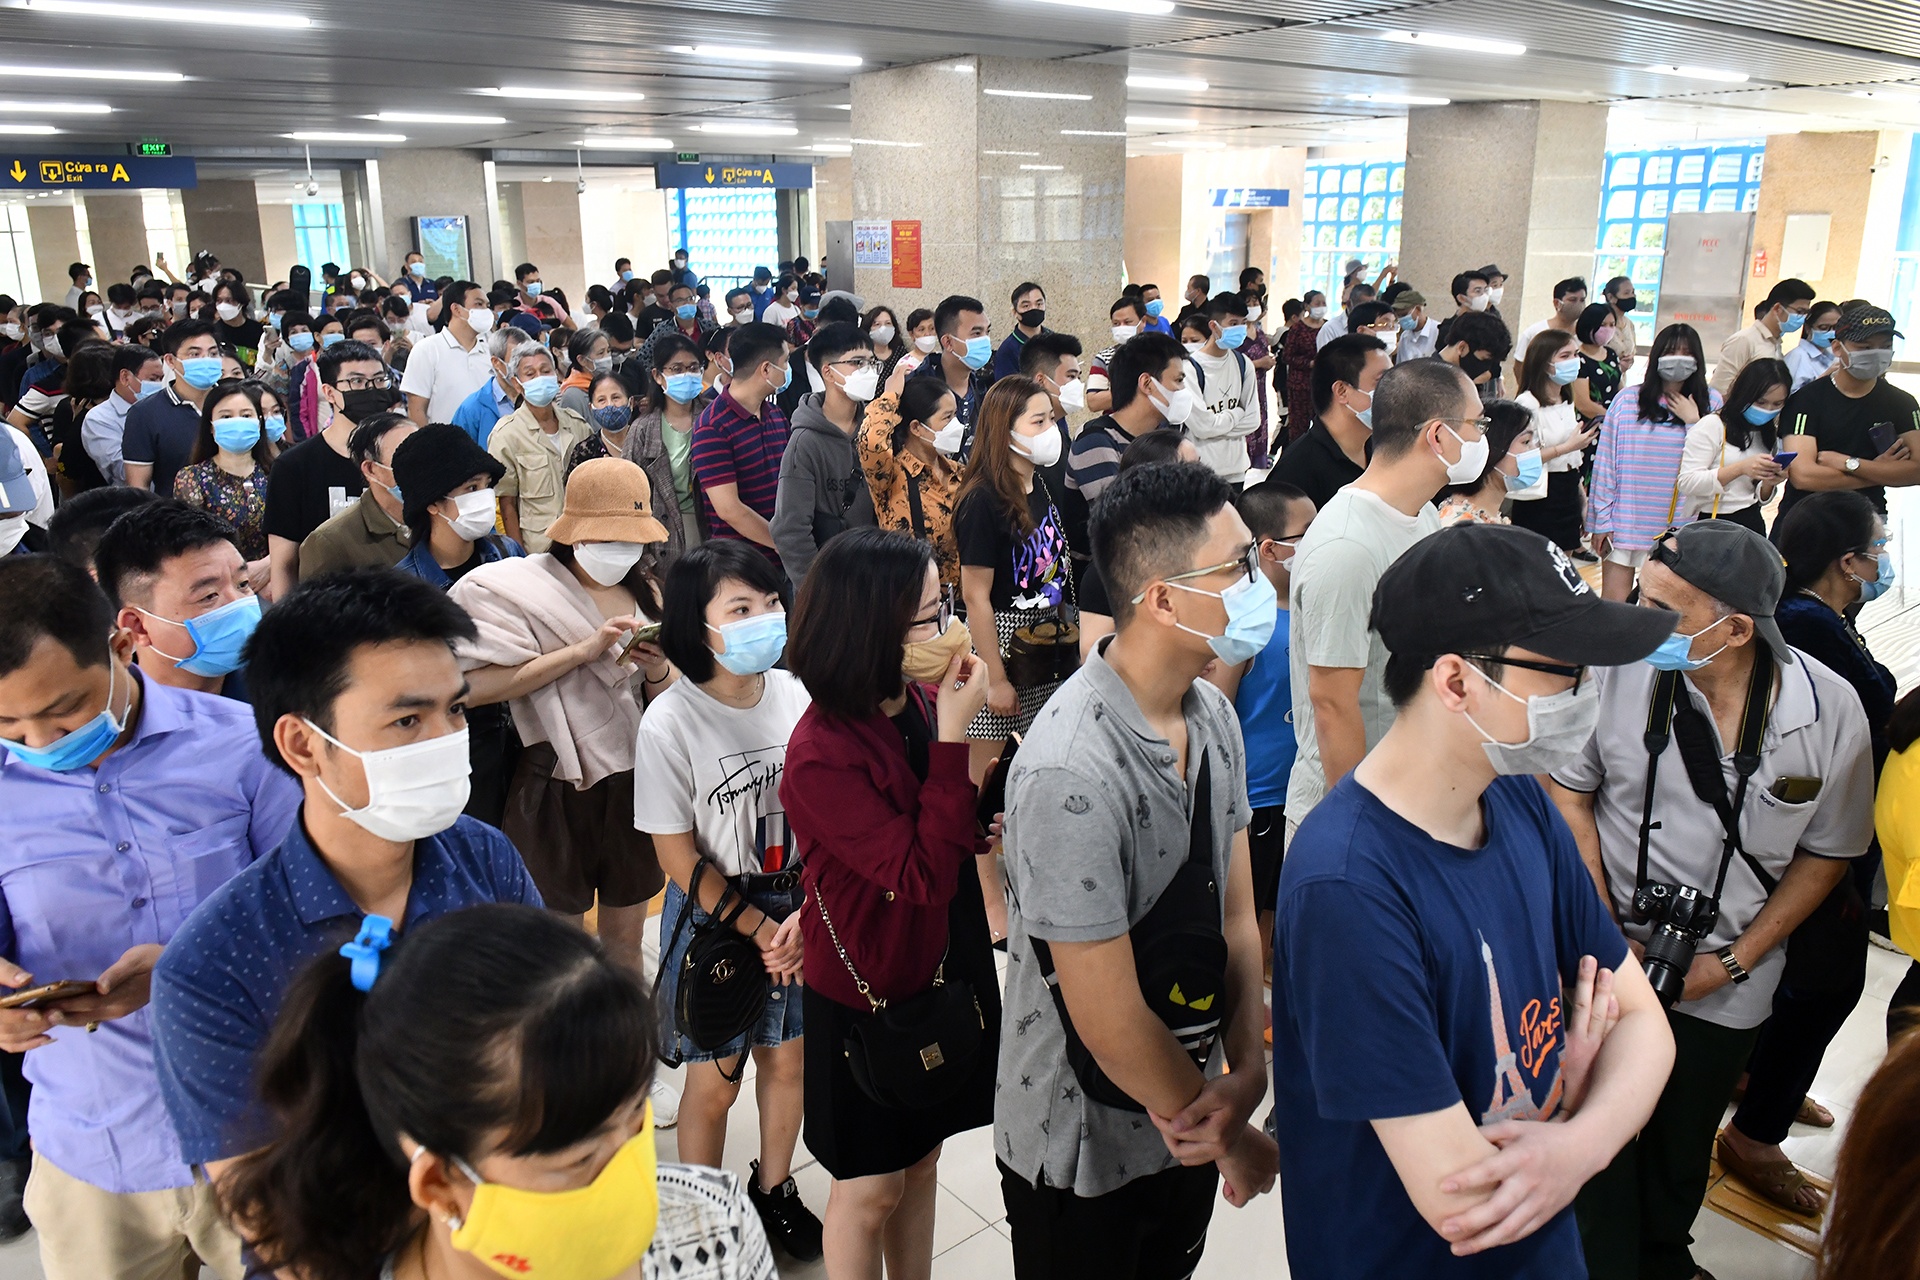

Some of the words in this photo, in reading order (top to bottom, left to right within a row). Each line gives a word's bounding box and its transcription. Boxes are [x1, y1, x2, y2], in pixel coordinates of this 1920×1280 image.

[65, 161, 92, 173] Cửa
[95, 163, 108, 173] ra
[111, 163, 130, 182] A
[66, 174, 83, 182] Exit
[762, 169, 774, 184] A
[634, 501, 643, 510] M
[707, 760, 764, 815] Tommy
[765, 763, 784, 790] Hi
